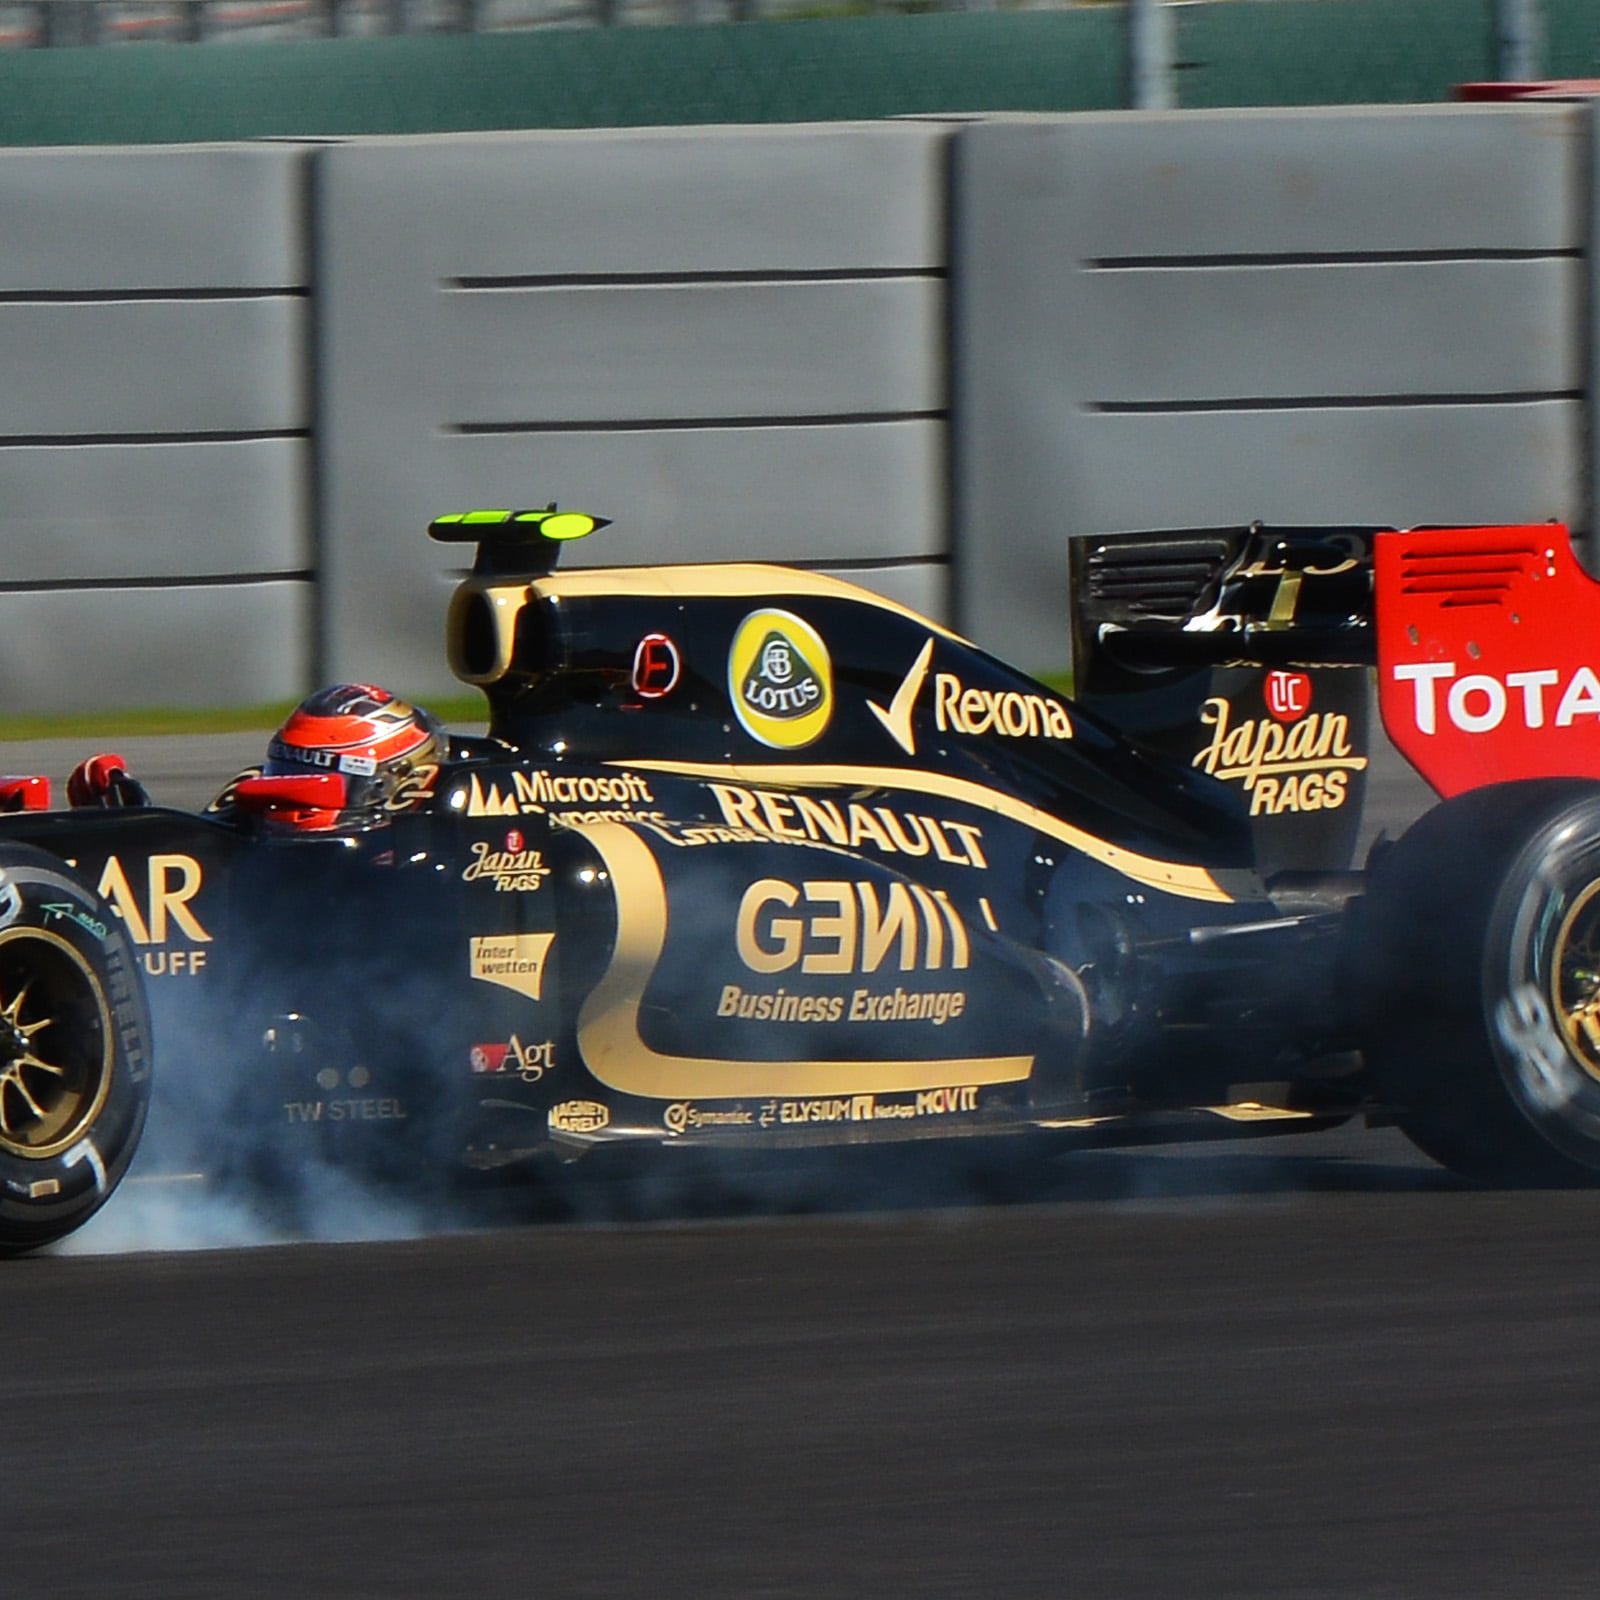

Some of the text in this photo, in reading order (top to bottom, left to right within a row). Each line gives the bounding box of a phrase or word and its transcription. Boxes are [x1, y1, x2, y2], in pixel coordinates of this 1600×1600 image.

[745, 677, 820, 711] LOTUS
[935, 673, 1073, 739] Rexona
[1191, 697, 1360, 790] Japan
[511, 770, 654, 803] Microsoft
[1249, 770, 1348, 816] RAGS
[707, 783, 988, 869] RENAULT
[96, 854, 214, 944] AR
[494, 874, 541, 892] RAGS
[144, 951, 206, 976] UFF
[716, 984, 965, 1025] Business Exchange
[283, 1098, 407, 1123] TW STEEL
